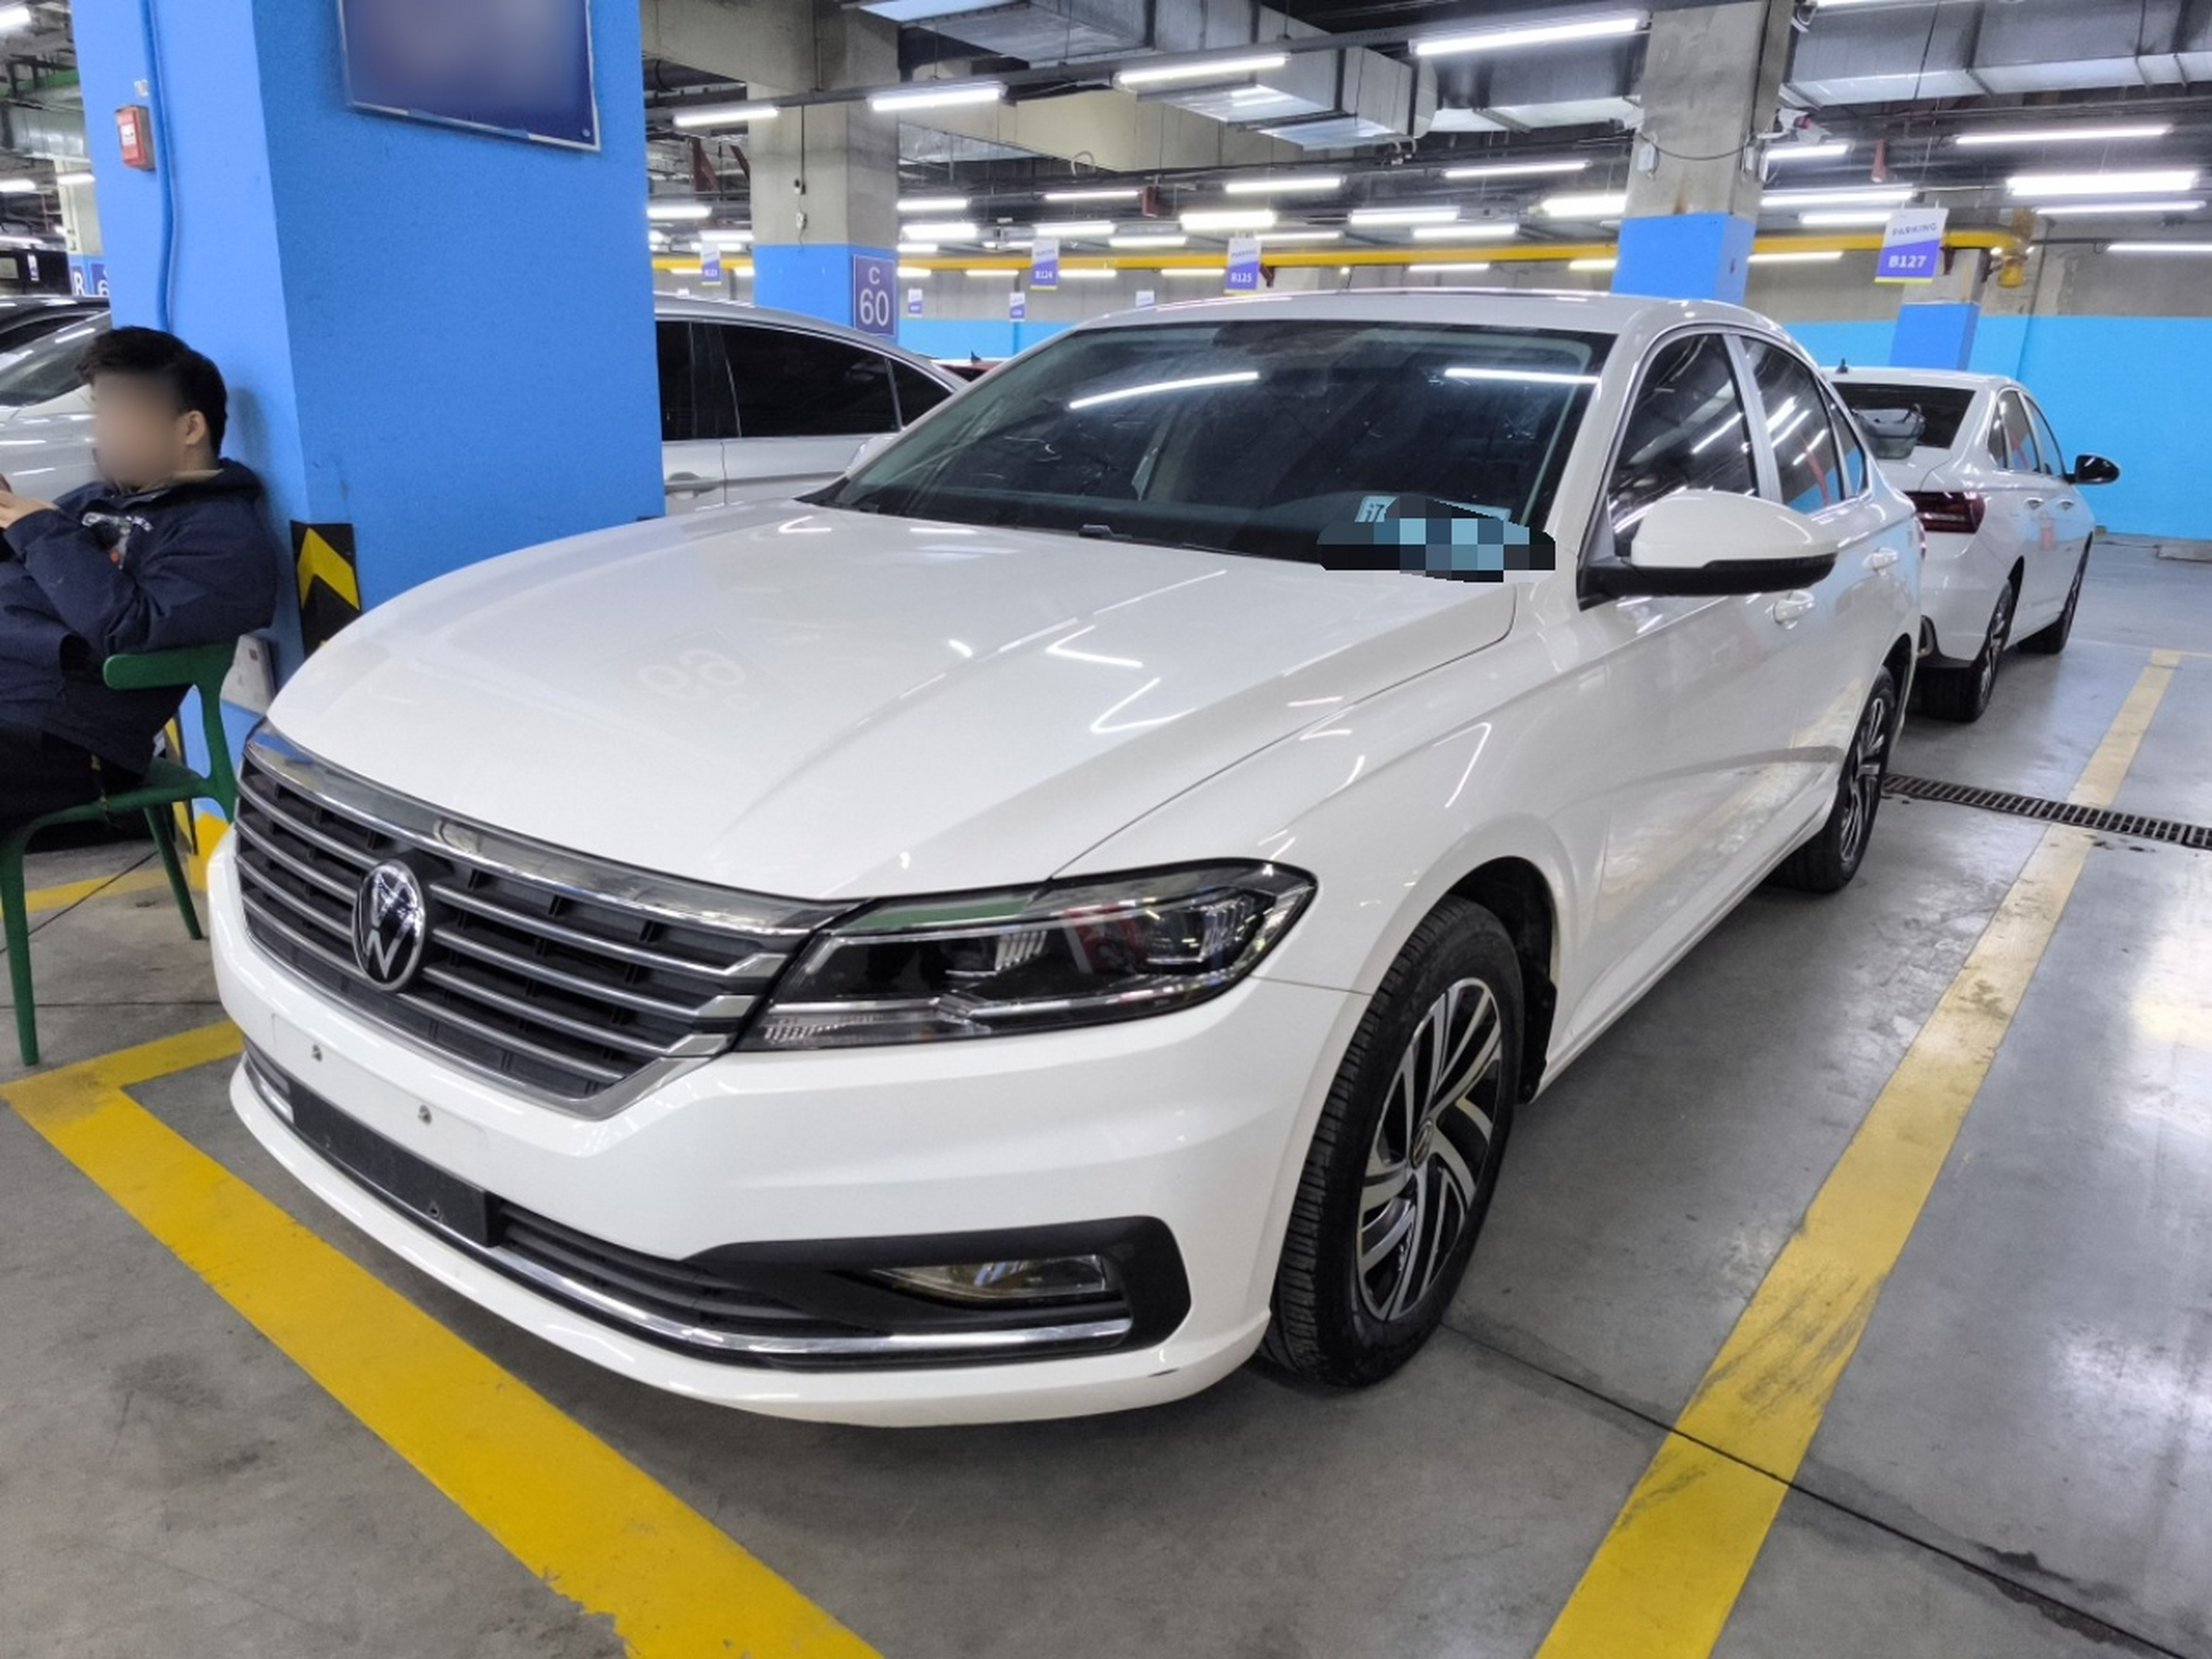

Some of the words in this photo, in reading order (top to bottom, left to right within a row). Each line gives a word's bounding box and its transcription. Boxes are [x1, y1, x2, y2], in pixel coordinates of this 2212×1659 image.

[1892, 222, 1937, 236] PARKING
[1888, 255, 1927, 268] B127
[869, 266, 880, 285] C
[1230, 272, 1252, 282] B125
[859, 287, 889, 327] 60
